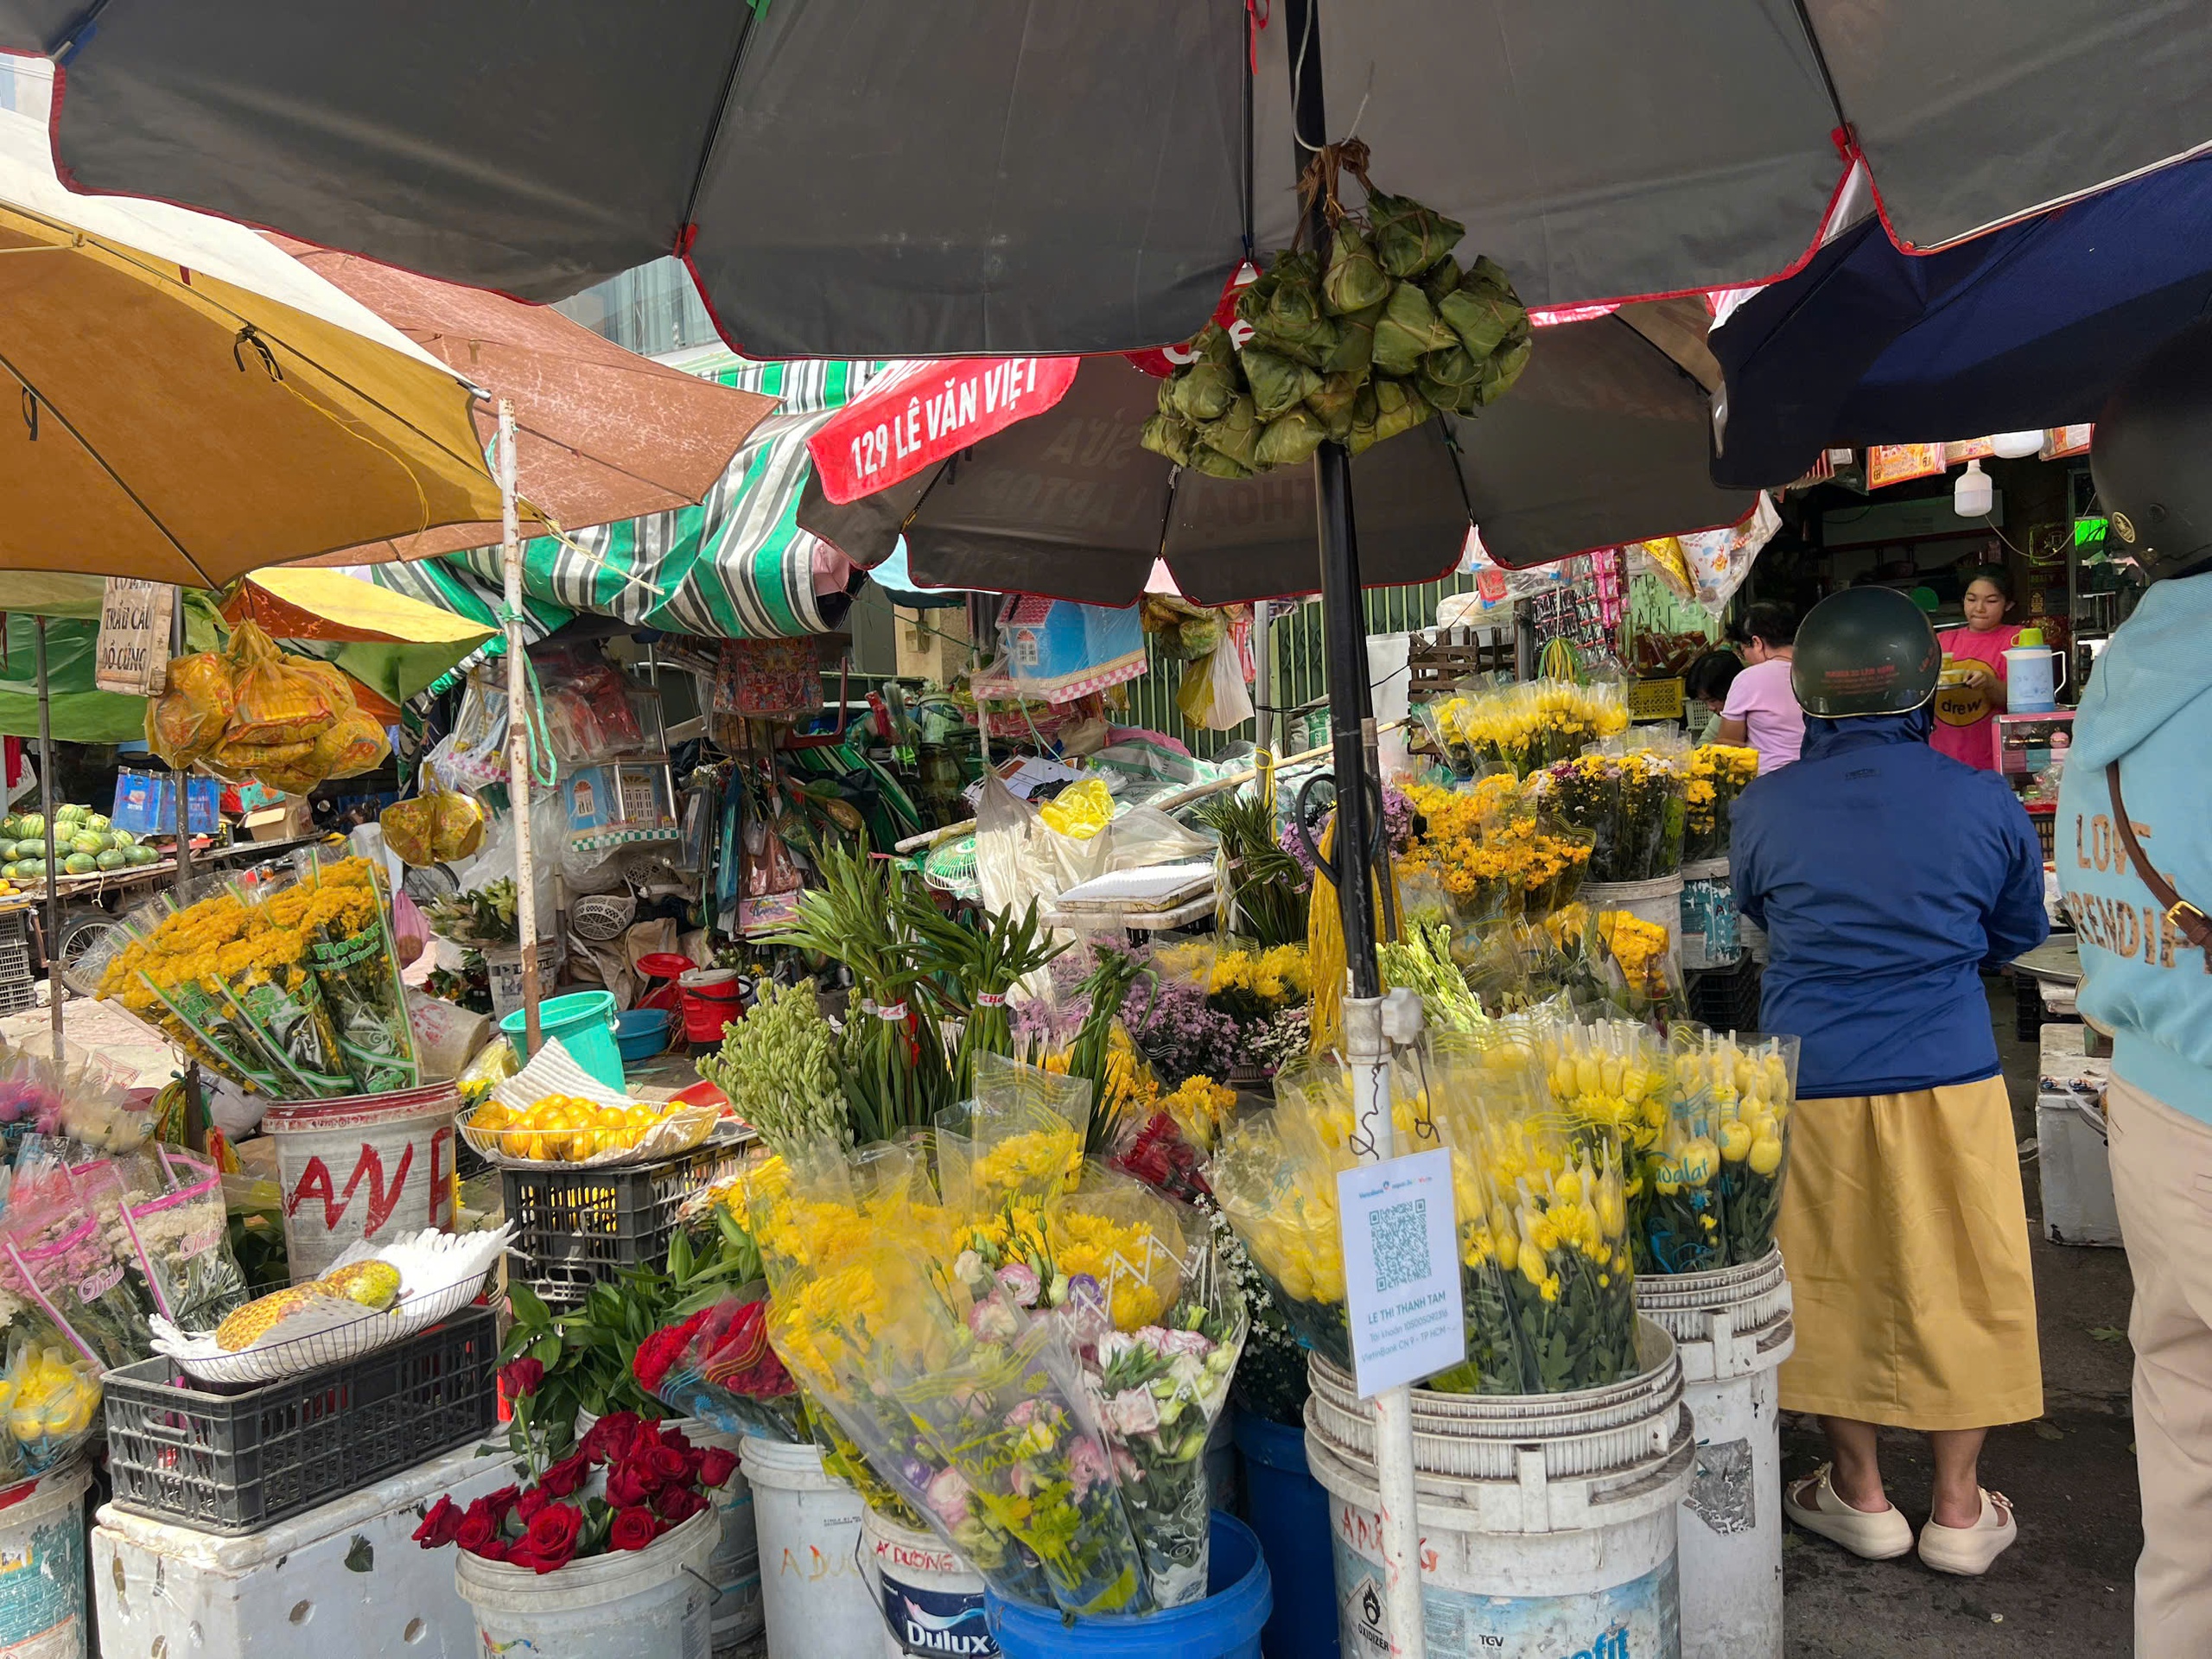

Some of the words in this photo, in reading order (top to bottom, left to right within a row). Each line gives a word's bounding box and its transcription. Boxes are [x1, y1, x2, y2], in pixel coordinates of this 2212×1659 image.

[851, 424, 888, 480] 129
[894, 397, 922, 459] LÊ
[925, 377, 977, 441] VĂN
[1941, 698, 1982, 715] drew
[312, 920, 380, 960] Flower
[1368, 1312, 1378, 1325] LE
[1397, 1297, 1427, 1316] THANH
[1427, 1290, 1446, 1304] TAM
[907, 1620, 991, 1654] Dulux
[1358, 1623, 1389, 1652] OXIDIZER
[1478, 1634, 1504, 1647] TGV
